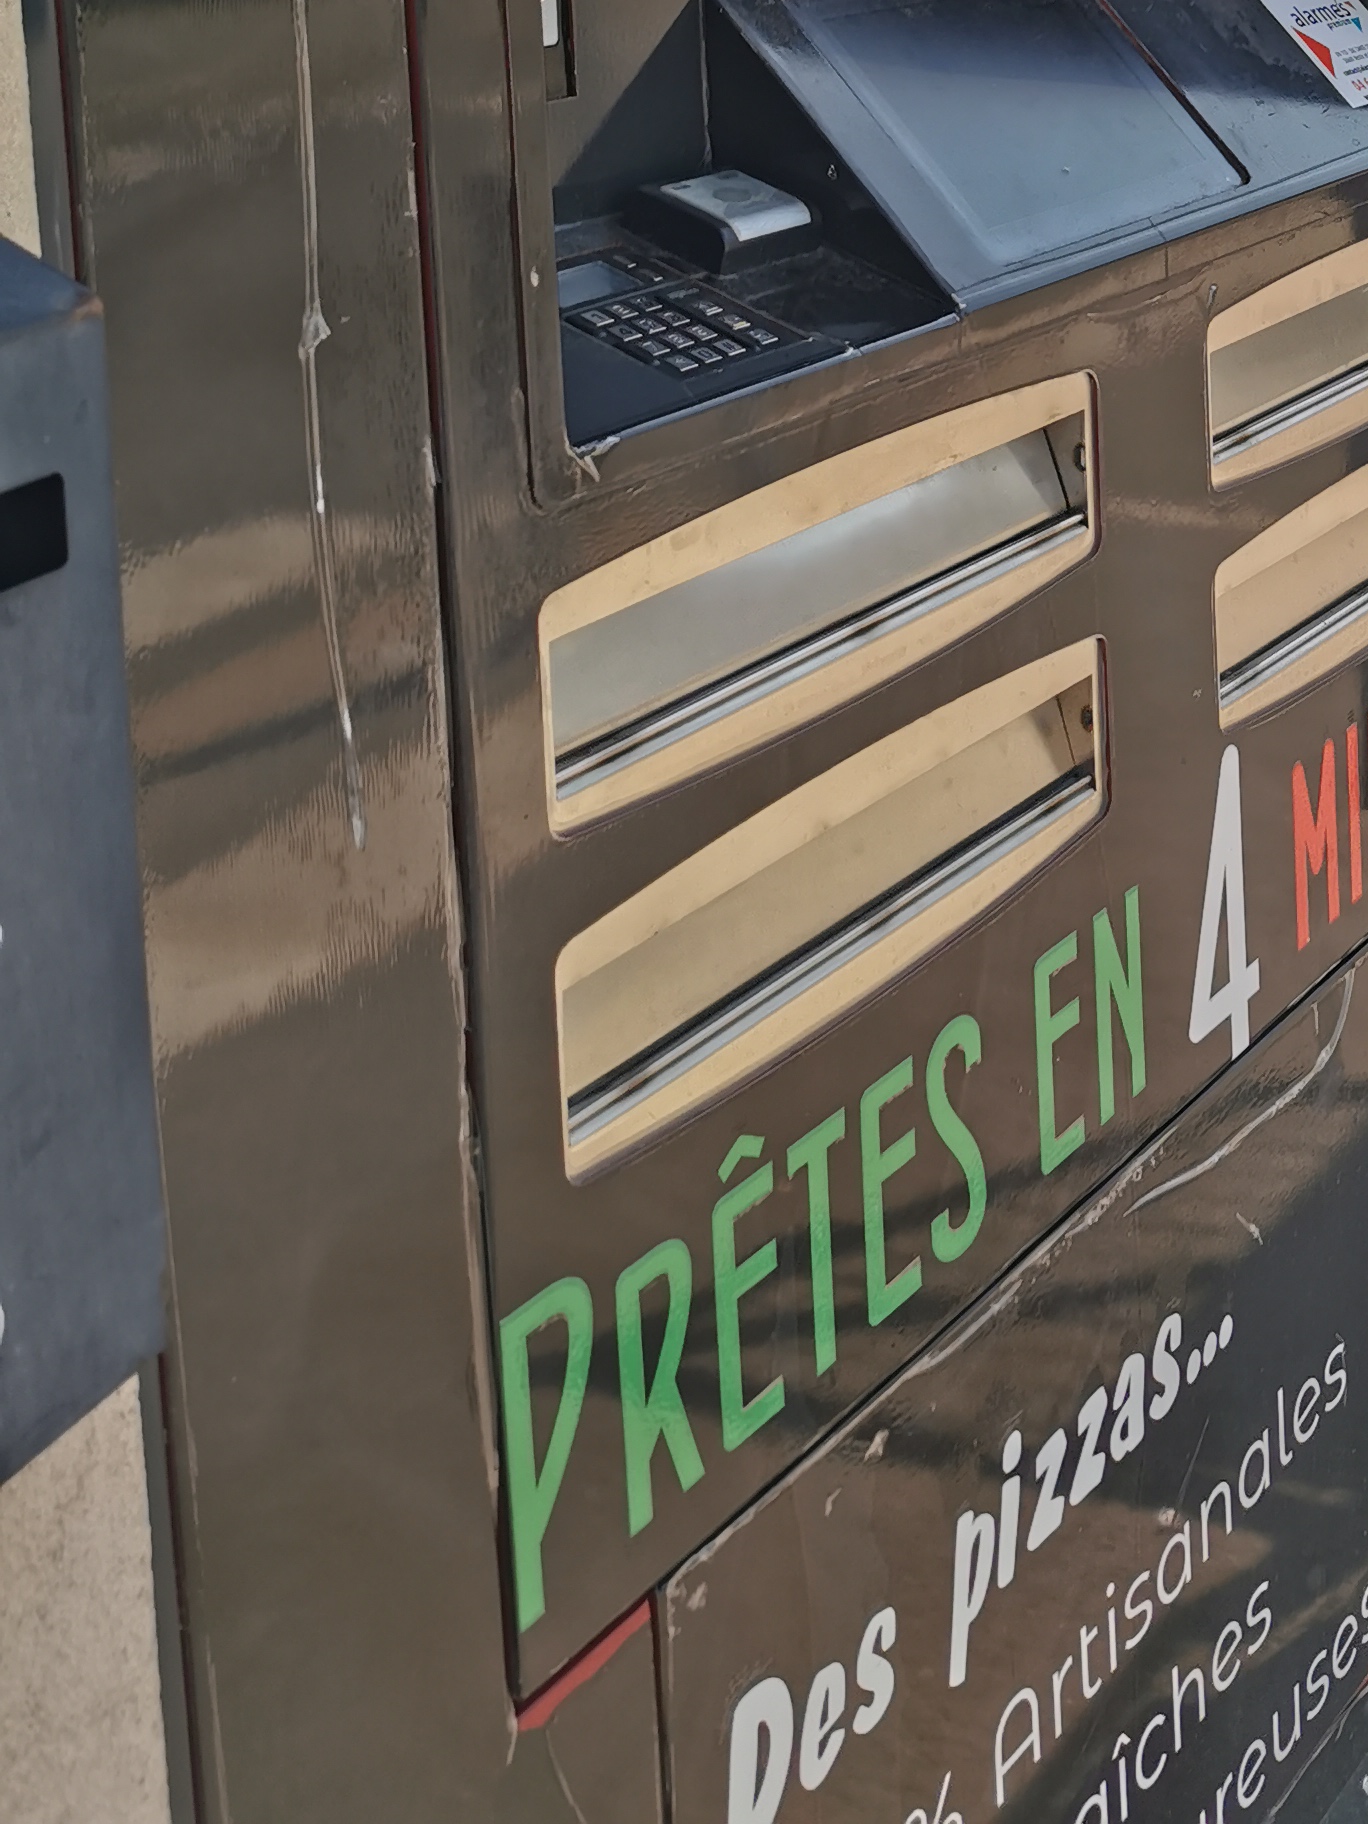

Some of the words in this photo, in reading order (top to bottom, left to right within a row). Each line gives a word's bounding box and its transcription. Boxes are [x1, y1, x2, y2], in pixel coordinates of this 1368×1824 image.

[499, 1014, 987, 1634] PRÊTES
[1033, 884, 1146, 1176] EN
[1188, 743, 1261, 1061] 4
[727, 1606, 897, 1824] Des
[948, 1312, 1234, 1687] pizzas...
[993, 1341, 1348, 1808] Artisanales
